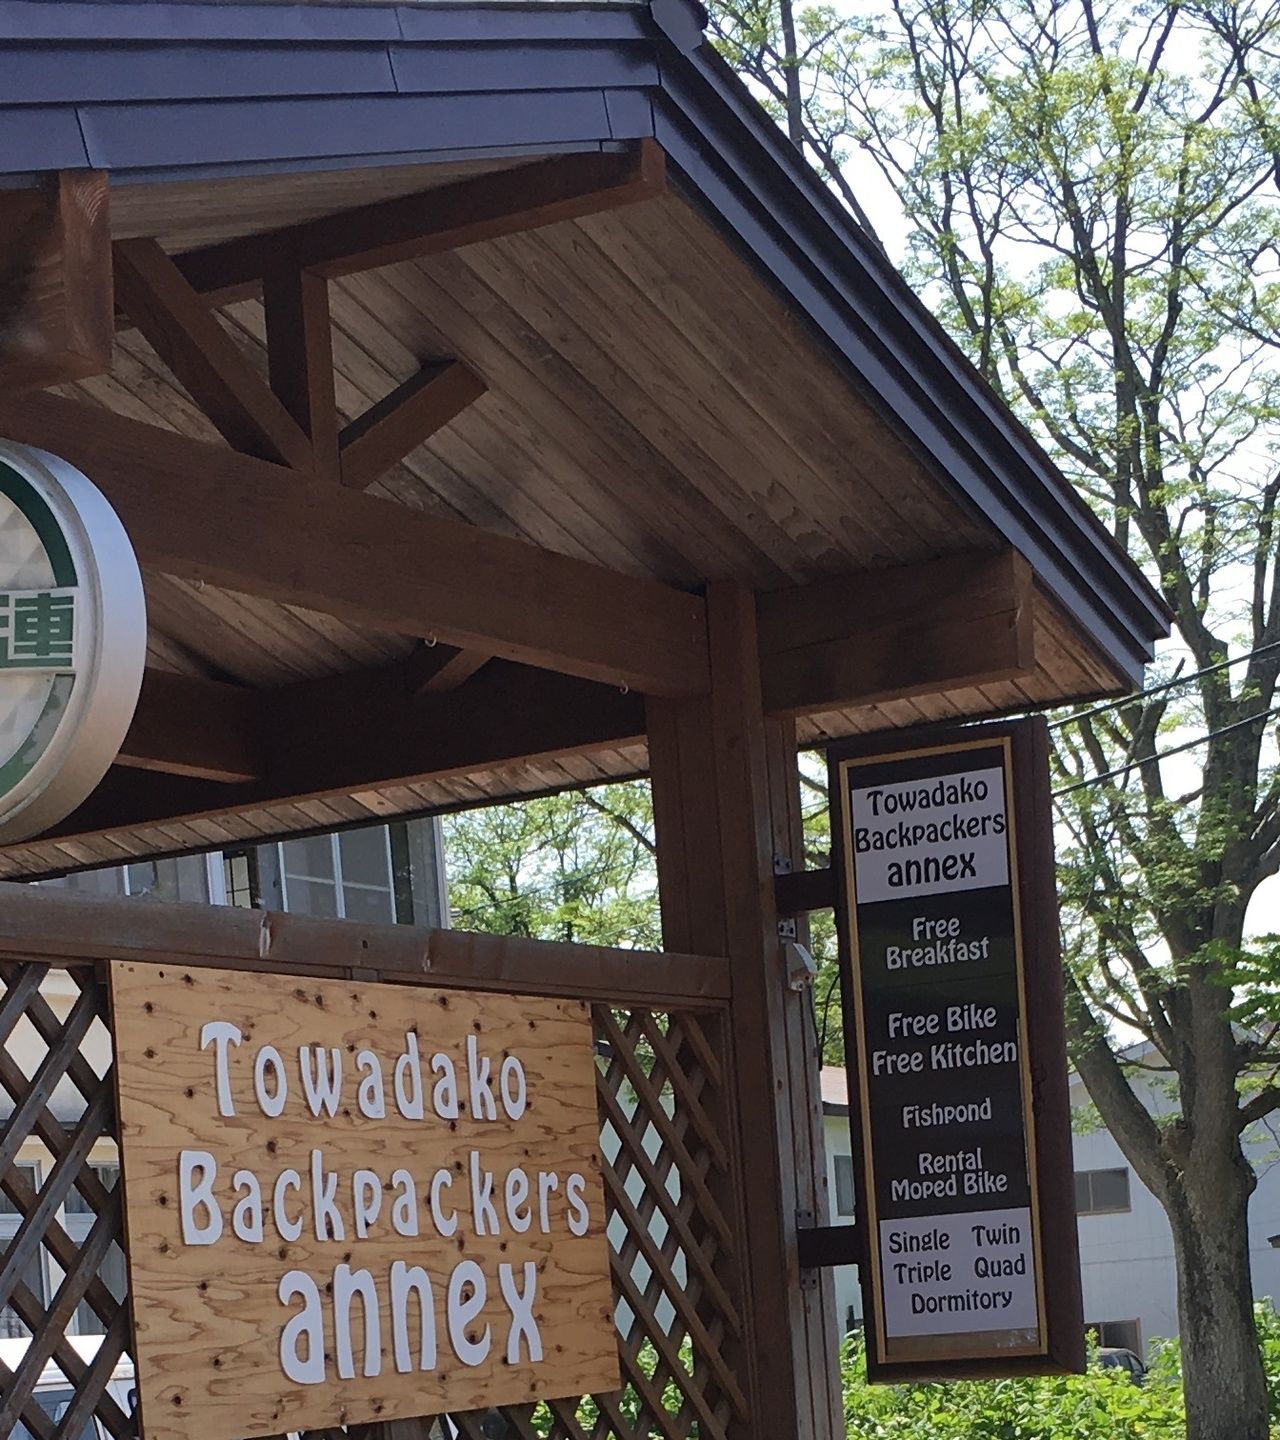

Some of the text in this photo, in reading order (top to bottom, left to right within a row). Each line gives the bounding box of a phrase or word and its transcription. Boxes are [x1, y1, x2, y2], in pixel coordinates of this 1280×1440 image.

[867, 777, 988, 816] Towadako
[855, 813, 1006, 853] Backpackers
[887, 852, 977, 888] annex
[912, 917, 960, 941] Free
[886, 936, 990, 970] Breakfast
[888, 1003, 997, 1038] Free Bike
[201, 1022, 527, 1121] Towadako
[872, 1040, 1017, 1075] Free Kitchen
[903, 1097, 992, 1128] Fishpond
[919, 1147, 983, 1175] Rental
[179, 1150, 589, 1245] Backpackers
[891, 1170, 1008, 1201] Moped Bike
[889, 1223, 1020, 1254] Single Twin
[893, 1253, 1026, 1284] Triple Quad
[911, 1289, 1013, 1315] Dormitory
[278, 1260, 543, 1384] annex
